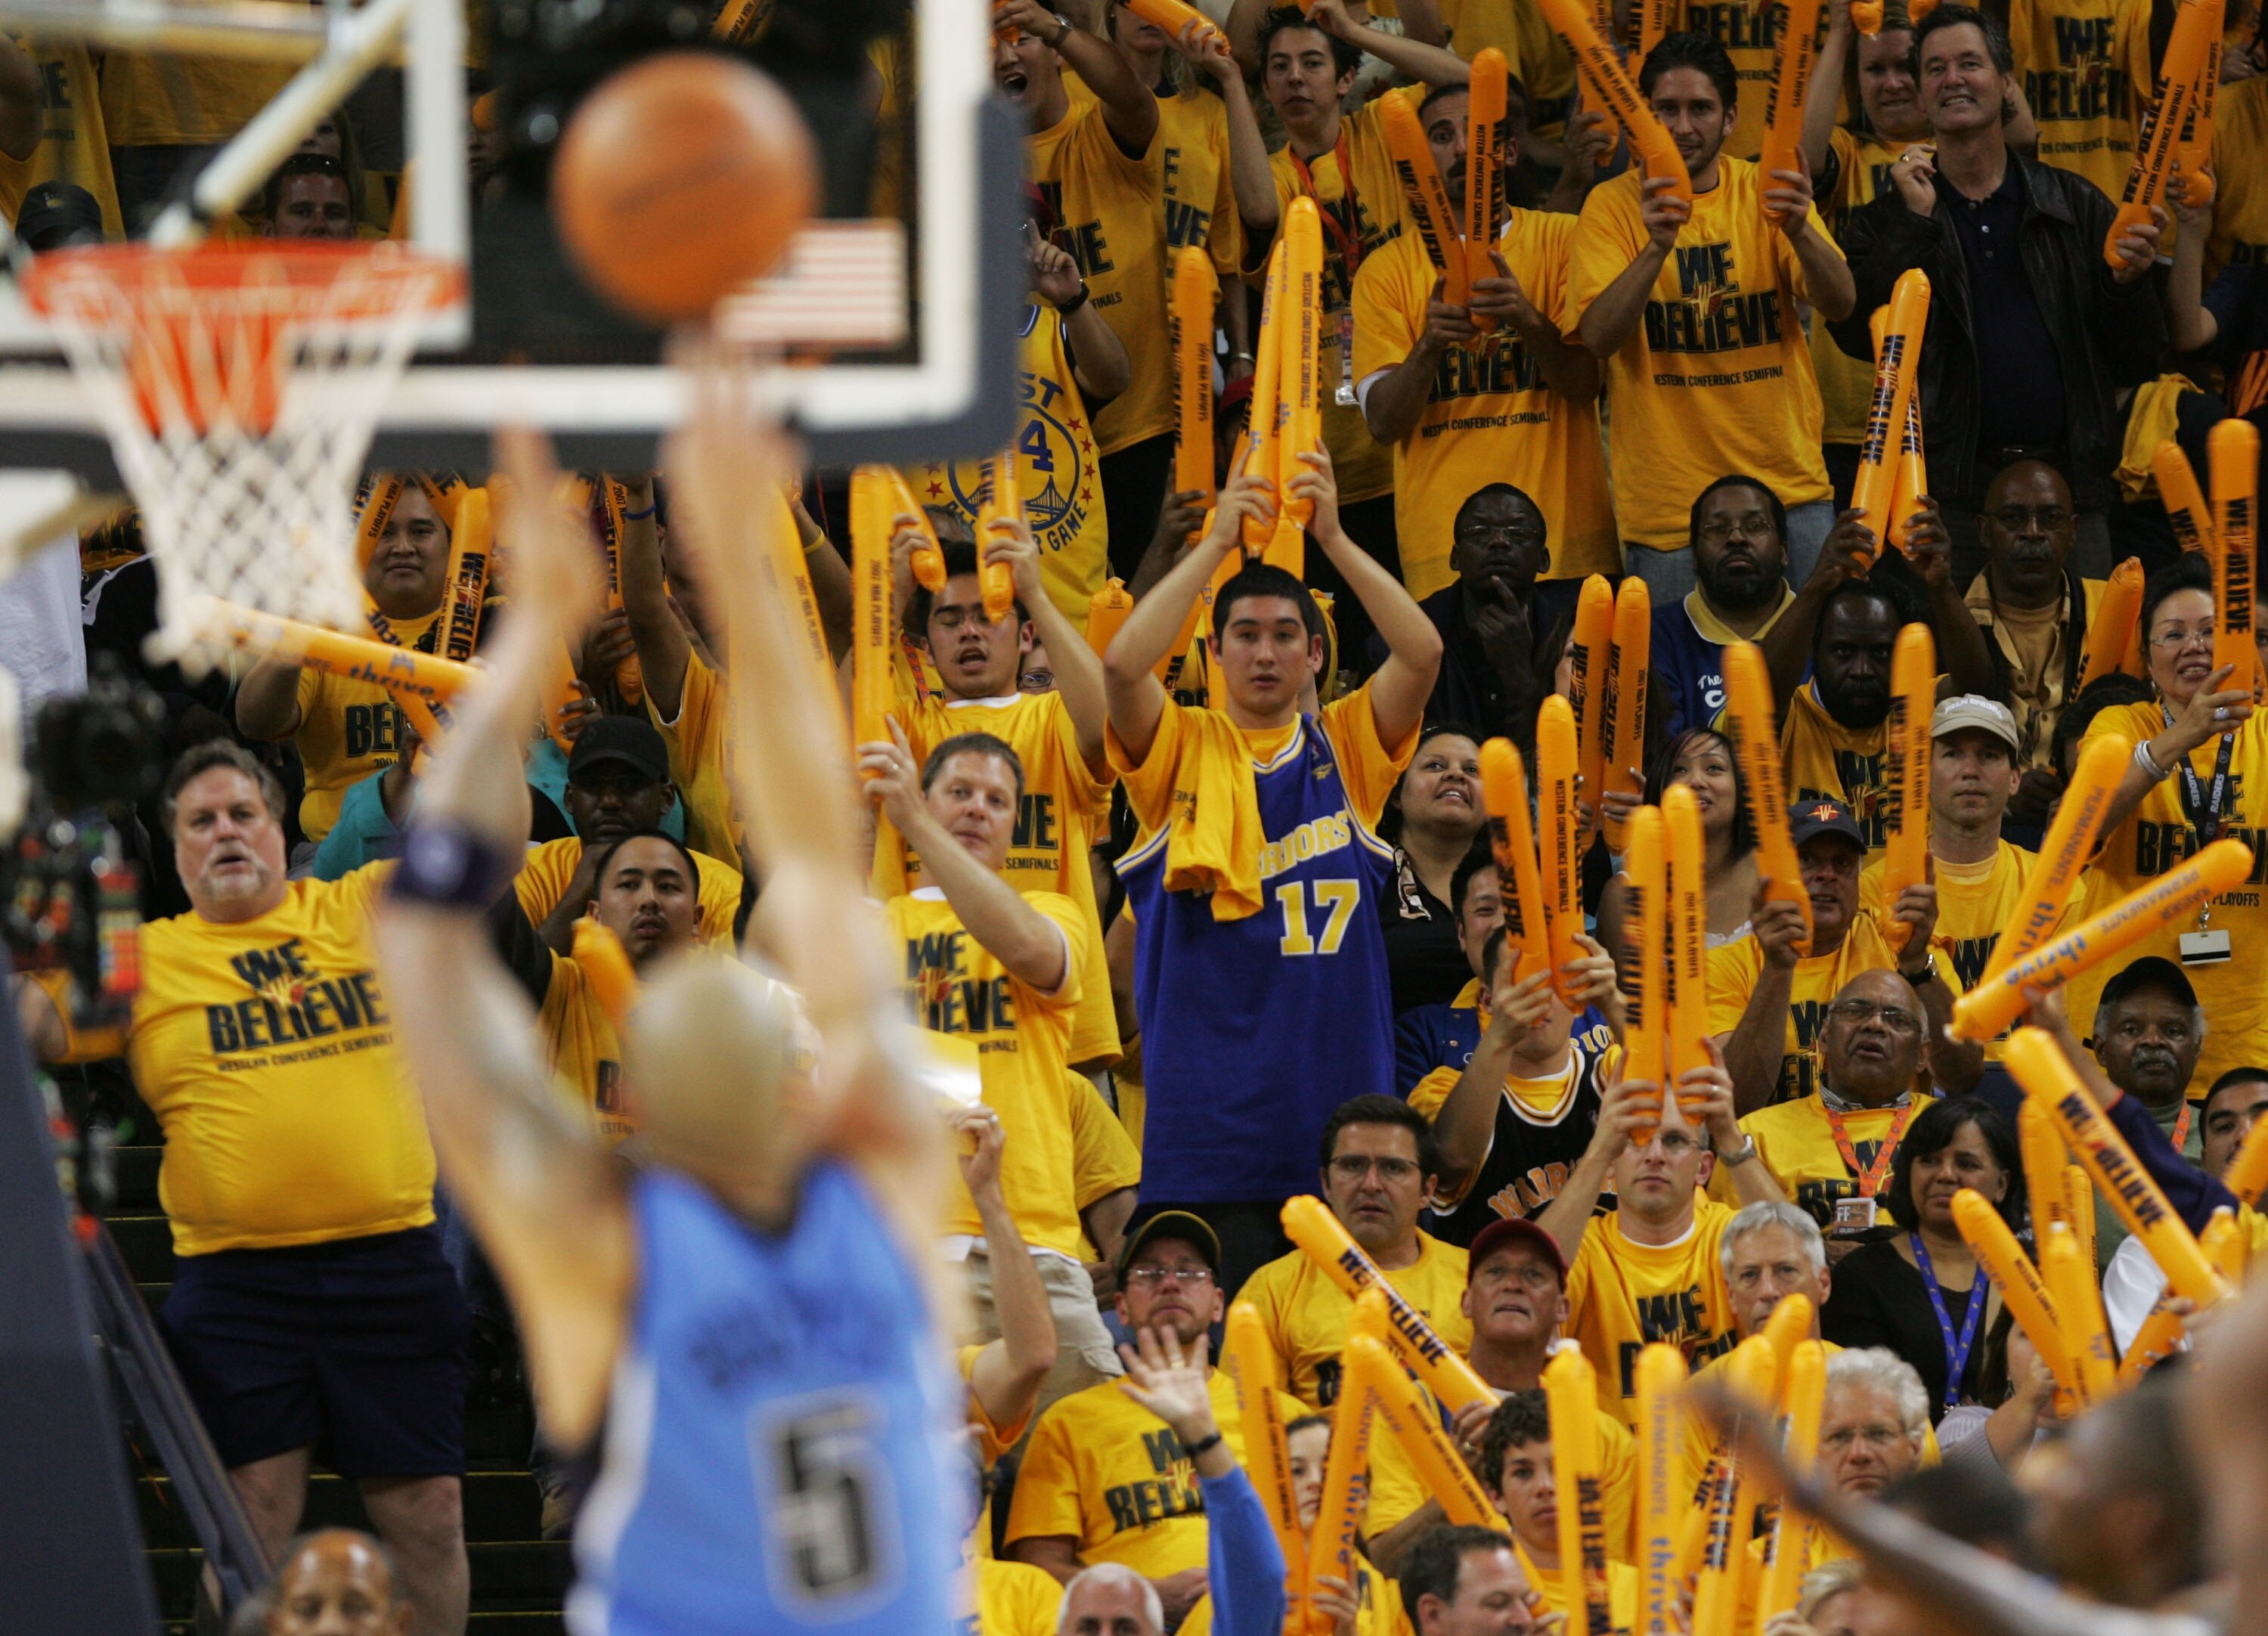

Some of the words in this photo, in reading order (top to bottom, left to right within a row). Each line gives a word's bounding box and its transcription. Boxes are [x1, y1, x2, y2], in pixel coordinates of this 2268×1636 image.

[2053, 14, 2116, 66] WE
[2207, 41, 2220, 81] PLAYOFFS
[1475, 124, 1486, 156] WESTERN
[2141, 172, 2159, 206] WESTERN
[2152, 126, 2174, 173] CONFERENCE
[2165, 83, 2186, 126] SEMIFINALS
[1473, 156, 1485, 196] CONFERENCE
[1473, 196, 1484, 242] SEMIFINALS
[1675, 240, 1740, 297] WE
[1092, 291, 1123, 310] FINALS
[1644, 290, 1783, 354] BELIEVE
[1427, 339, 1551, 404] ELIEV
[1879, 334, 1907, 370] WE
[1019, 370, 1065, 409] ST
[1687, 371, 1741, 388] CONFERENCE
[1743, 365, 1783, 384] SEMIFINA
[1452, 414, 1508, 429] CONFERENCE
[1860, 386, 1896, 466] BELIEVE
[1019, 419, 1055, 473] 4
[385, 482, 400, 500] NBA
[612, 485, 627, 505] 2007
[2226, 497, 2248, 528] WE
[367, 500, 392, 539] PLAYOFFS
[1046, 500, 1088, 552] GAME
[458, 552, 486, 584] WE
[2225, 553, 2251, 635] BELIEVE
[445, 602, 478, 662] BELIE
[1696, 674, 1724, 690] The
[1555, 778, 1566, 814] WESTERN
[2183, 766, 2201, 809] RAIDERS
[2209, 773, 2225, 814] RAIDERS
[1005, 857, 1058, 872] SEMIFINALS
[1259, 809, 1352, 881] RIORS
[1556, 816, 1569, 866] CONFERENCE
[1557, 867, 1570, 914] SEMIFINALS
[2212, 891, 2260, 908] PLAYOFFS
[1275, 878, 1361, 956] 17
[230, 937, 321, 991] WE
[906, 930, 968, 980] WE
[1686, 934, 1699, 979] PLAYOFFS
[2005, 932, 2087, 986] thrive
[206, 968, 391, 1055] BELIEVE
[905, 974, 1018, 1033] IEVE
[2057, 1090, 2094, 1130] WE
[2094, 1142, 2169, 1235] BELIEVE
[1487, 1156, 1583, 1220] WARR
[1636, 1283, 1713, 1342] WE
[1141, 1427, 1186, 1474] W
[760, 1391, 894, 1614] 5
